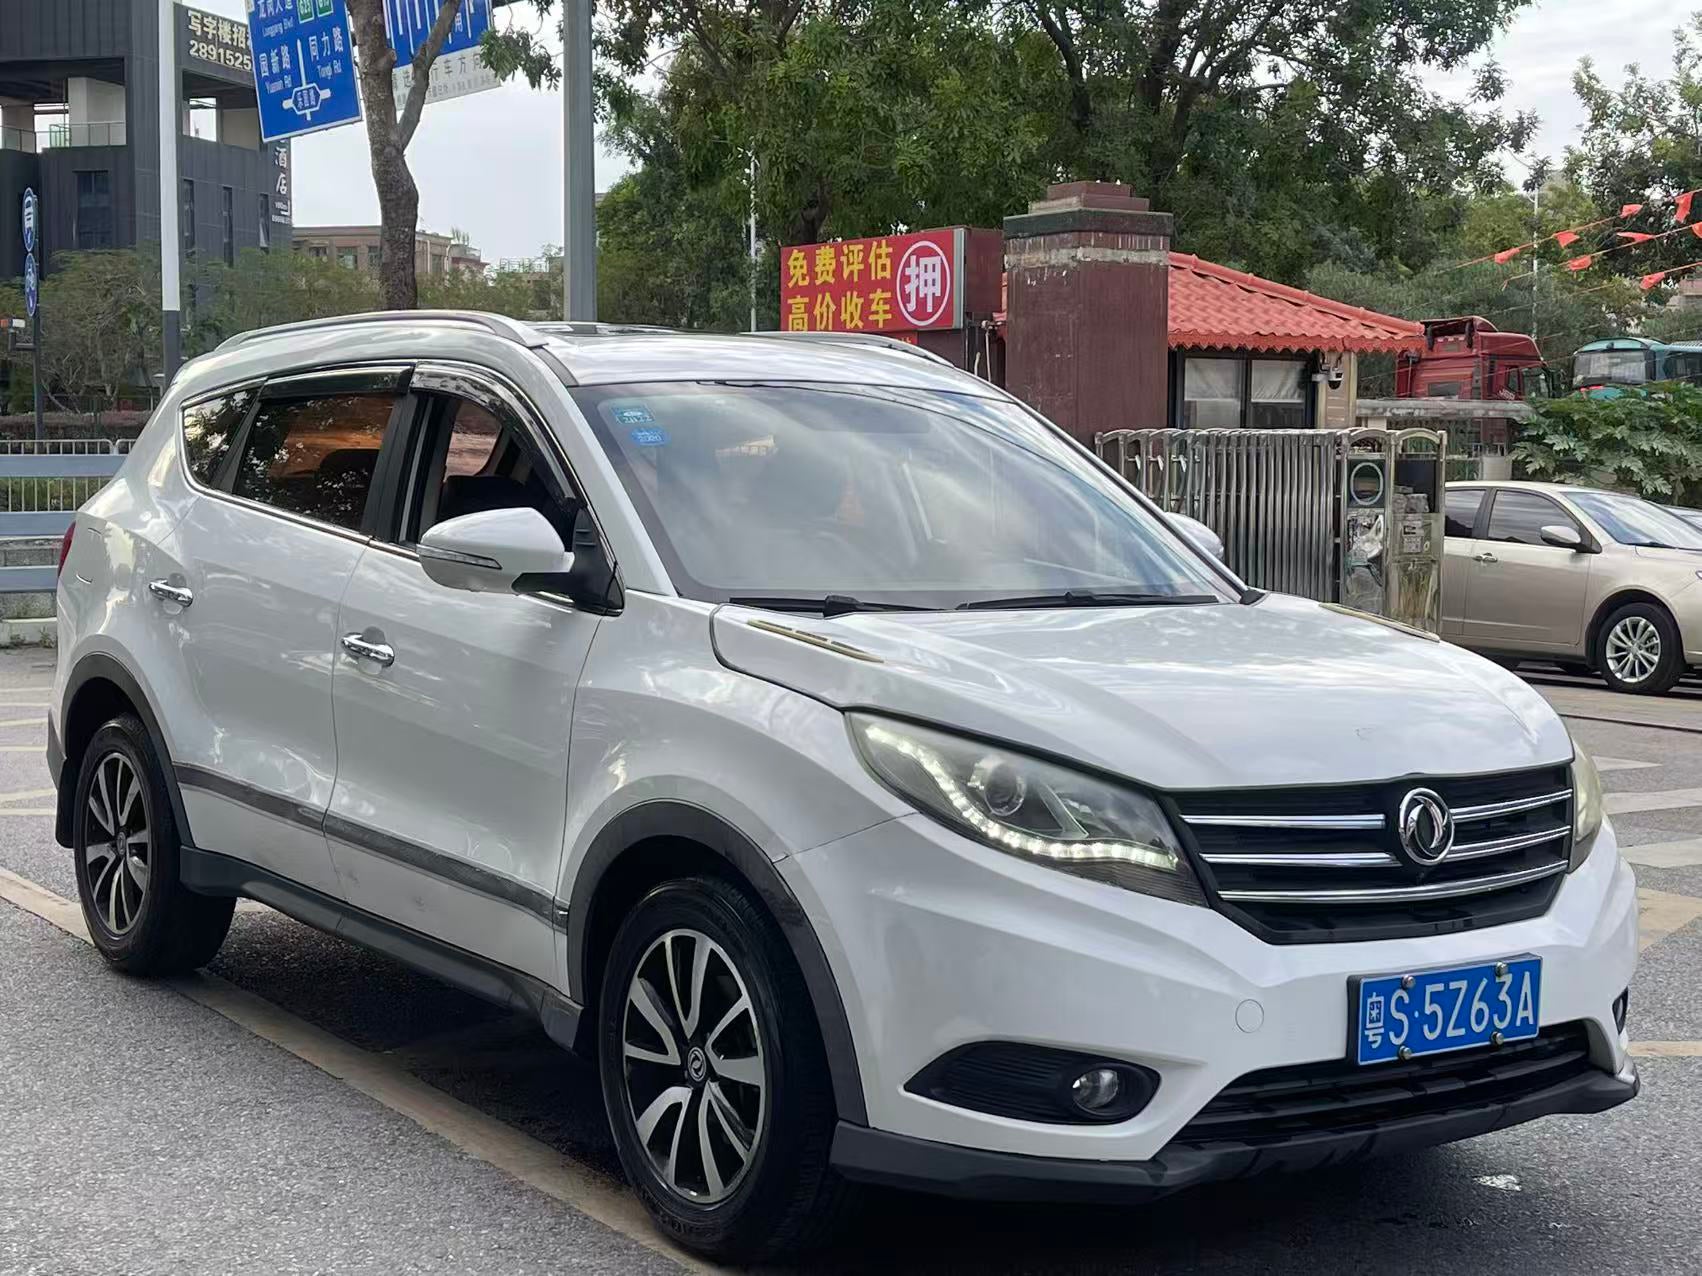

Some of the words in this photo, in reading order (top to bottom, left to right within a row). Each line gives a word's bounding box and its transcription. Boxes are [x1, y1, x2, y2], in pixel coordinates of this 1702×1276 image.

[188, 10, 250, 49] 写字楼招
[308, 26, 344, 62] 同力路
[189, 40, 252, 71] 2891525
[259, 44, 291, 78] 园新路
[275, 140, 288, 195] 酒店
[787, 240, 893, 288] 免费评估
[904, 254, 942, 313] 押
[787, 288, 893, 332] 高价收车
